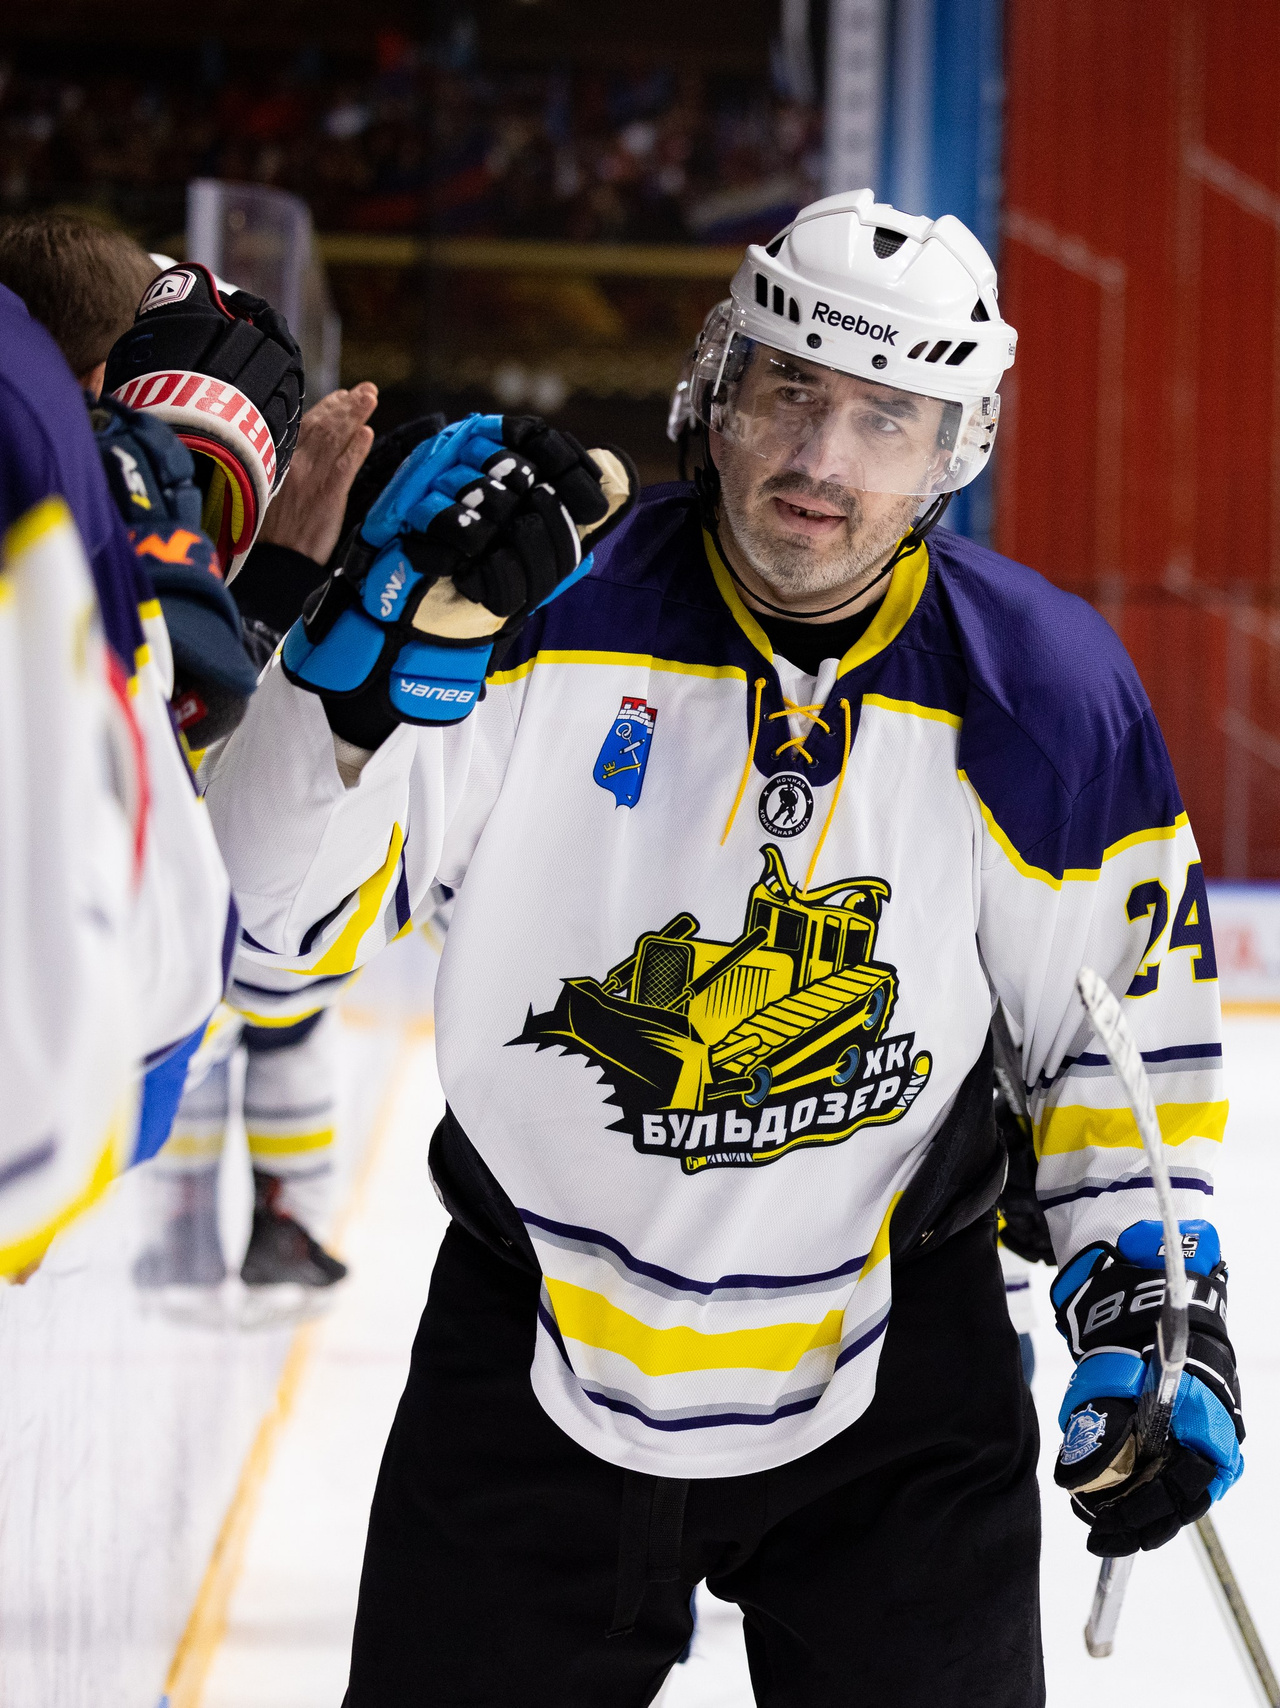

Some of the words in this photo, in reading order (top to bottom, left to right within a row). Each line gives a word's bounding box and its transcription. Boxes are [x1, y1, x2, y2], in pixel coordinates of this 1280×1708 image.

[811, 301, 900, 346] Reebok
[776, 777, 806, 789] НОЧНАЯ
[760, 809, 793, 836] ХОККЕЙНАЯ
[795, 817, 810, 833] ЛИГА
[1123, 860, 1218, 999] 24
[862, 1039, 909, 1080] ХК
[642, 1075, 902, 1150] БУЛЬДОЗЕР
